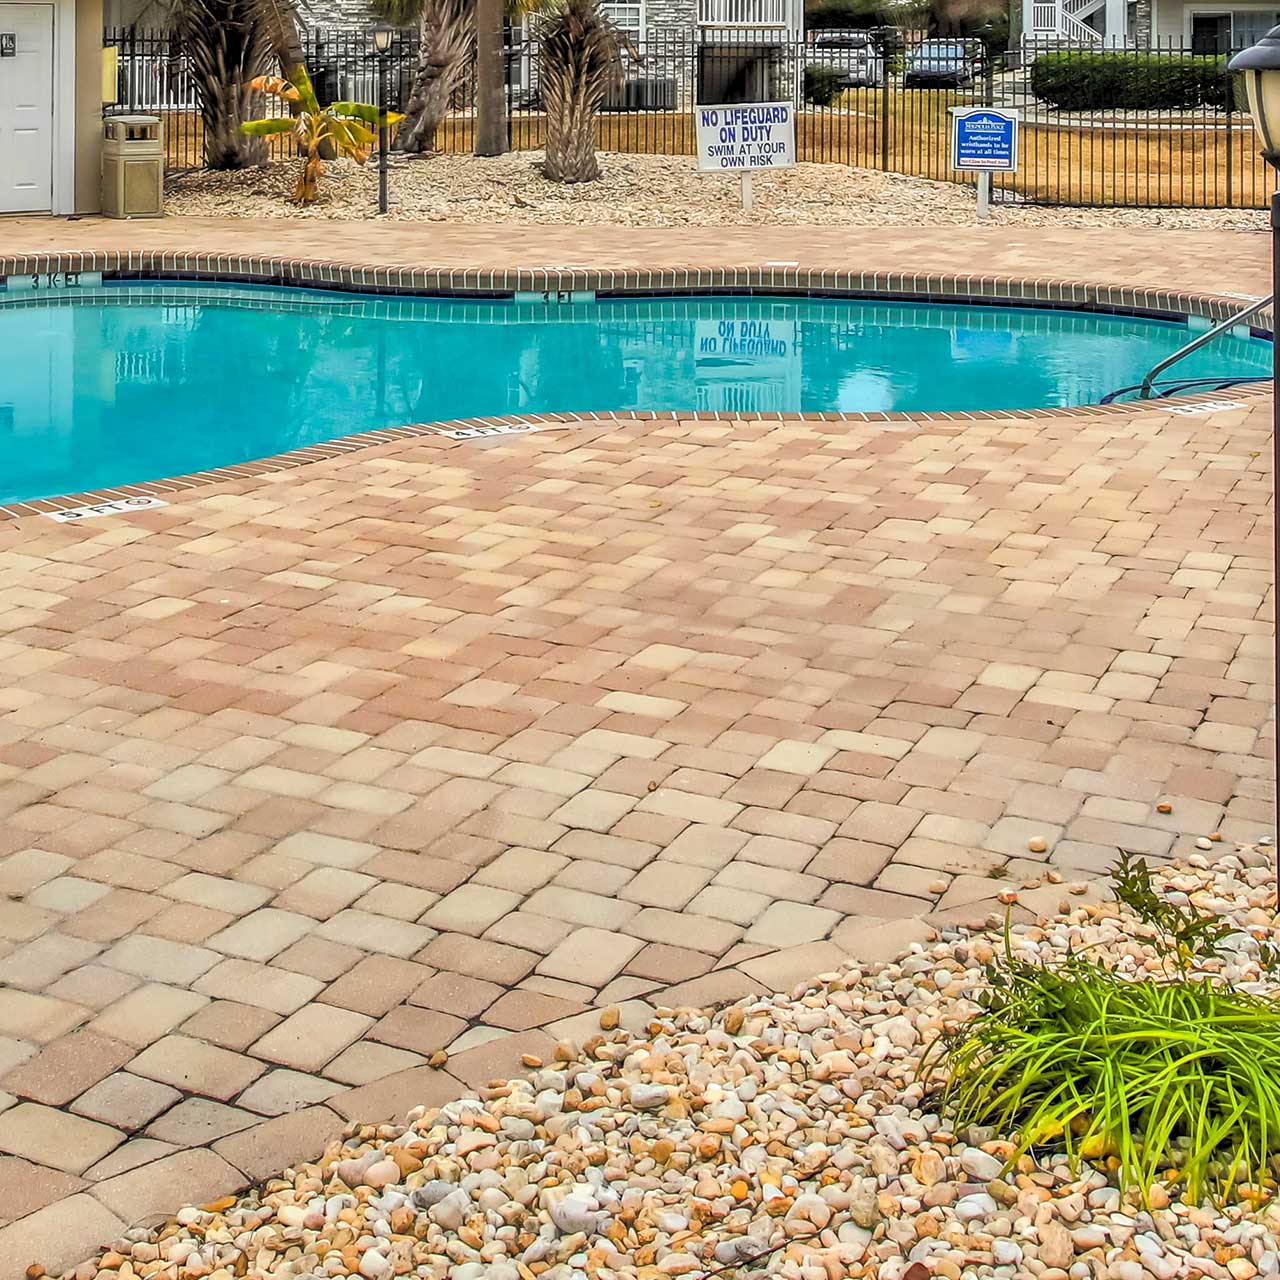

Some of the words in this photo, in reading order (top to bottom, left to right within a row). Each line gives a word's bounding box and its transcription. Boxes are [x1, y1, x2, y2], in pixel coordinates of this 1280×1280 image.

[702, 111, 718, 127] NO
[724, 107, 788, 126] LIFEGUARD
[719, 127, 736, 143] ON
[742, 125, 772, 142] DUTY
[708, 145, 734, 157] SWIM
[740, 144, 752, 155] AT
[757, 142, 786, 154] YOUR
[721, 157, 745, 168] OWN
[750, 155, 773, 167] RISK
[32, 273, 39, 290] 3
[88, 504, 122, 513] FT
